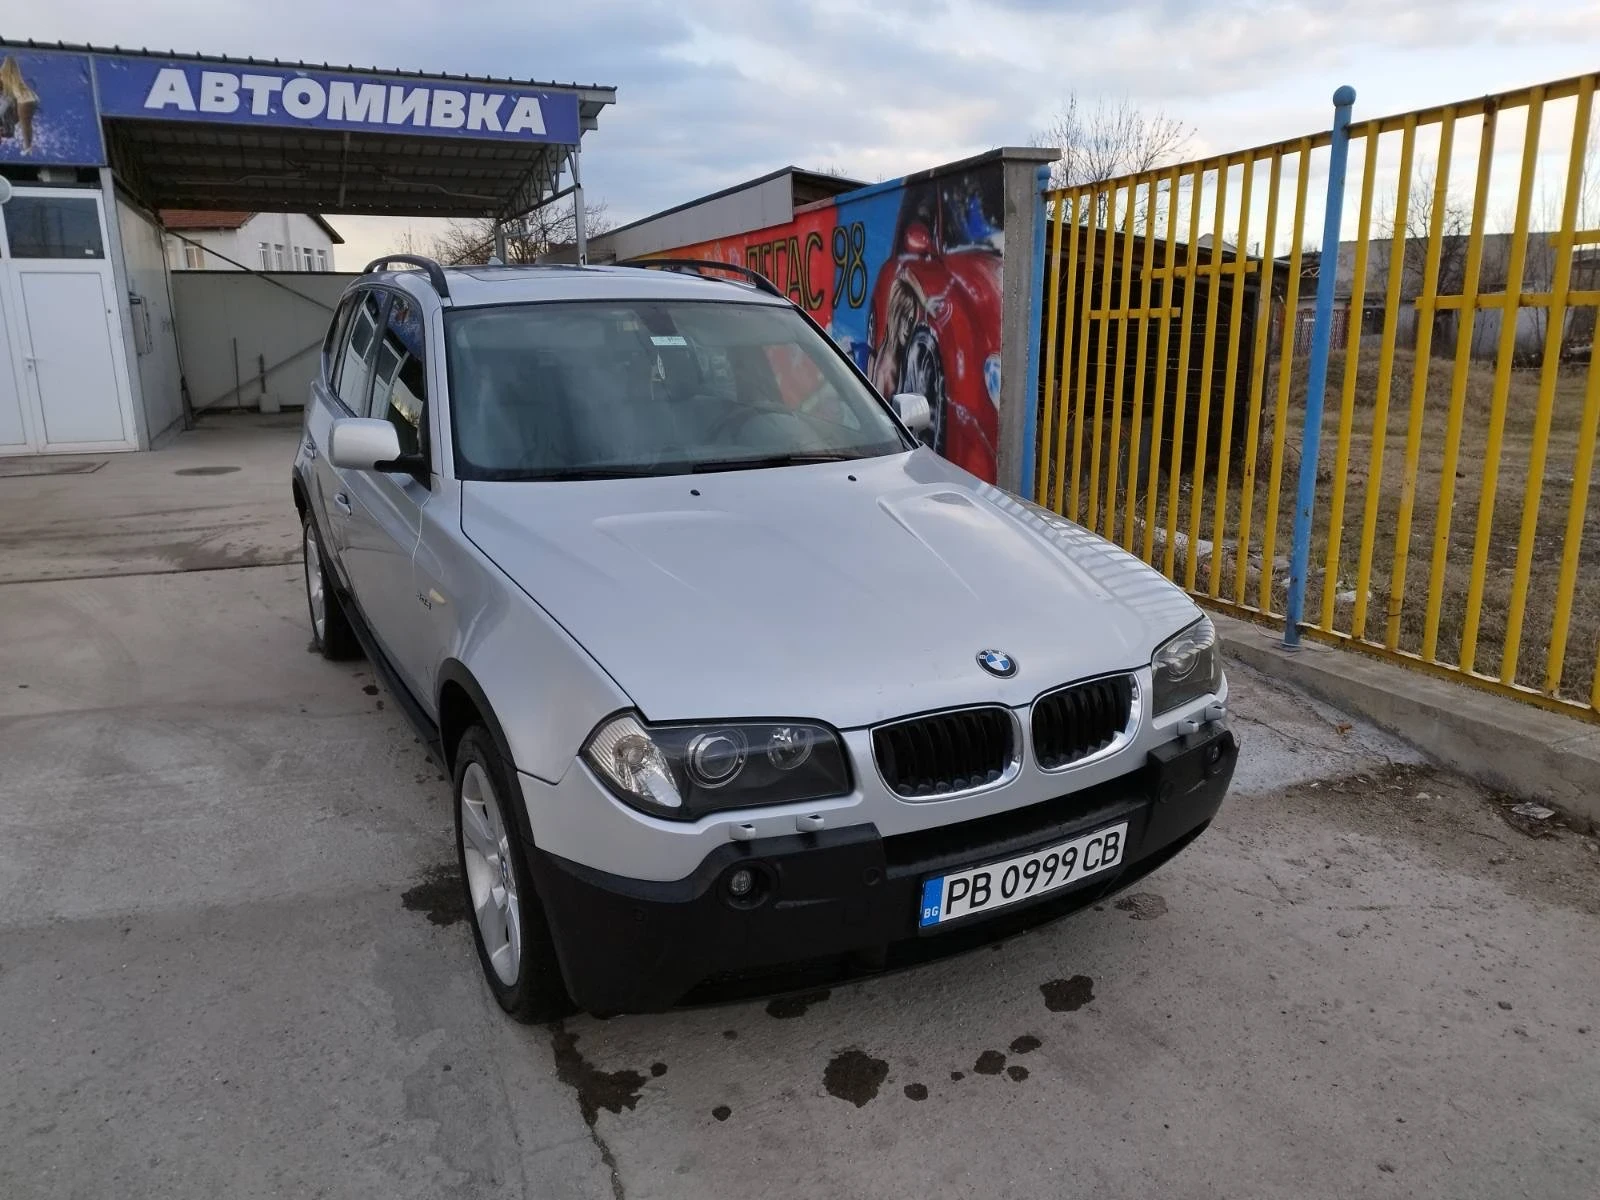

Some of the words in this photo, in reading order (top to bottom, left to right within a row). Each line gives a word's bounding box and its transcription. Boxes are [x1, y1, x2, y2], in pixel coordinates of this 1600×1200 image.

[144, 67, 547, 135] АВТОМИВКА
[832, 221, 868, 309] 98
[945, 872, 992, 915] PB
[1000, 846, 1078, 899] 0999
[1082, 831, 1120, 872] CB
[923, 905, 939, 918] BG
